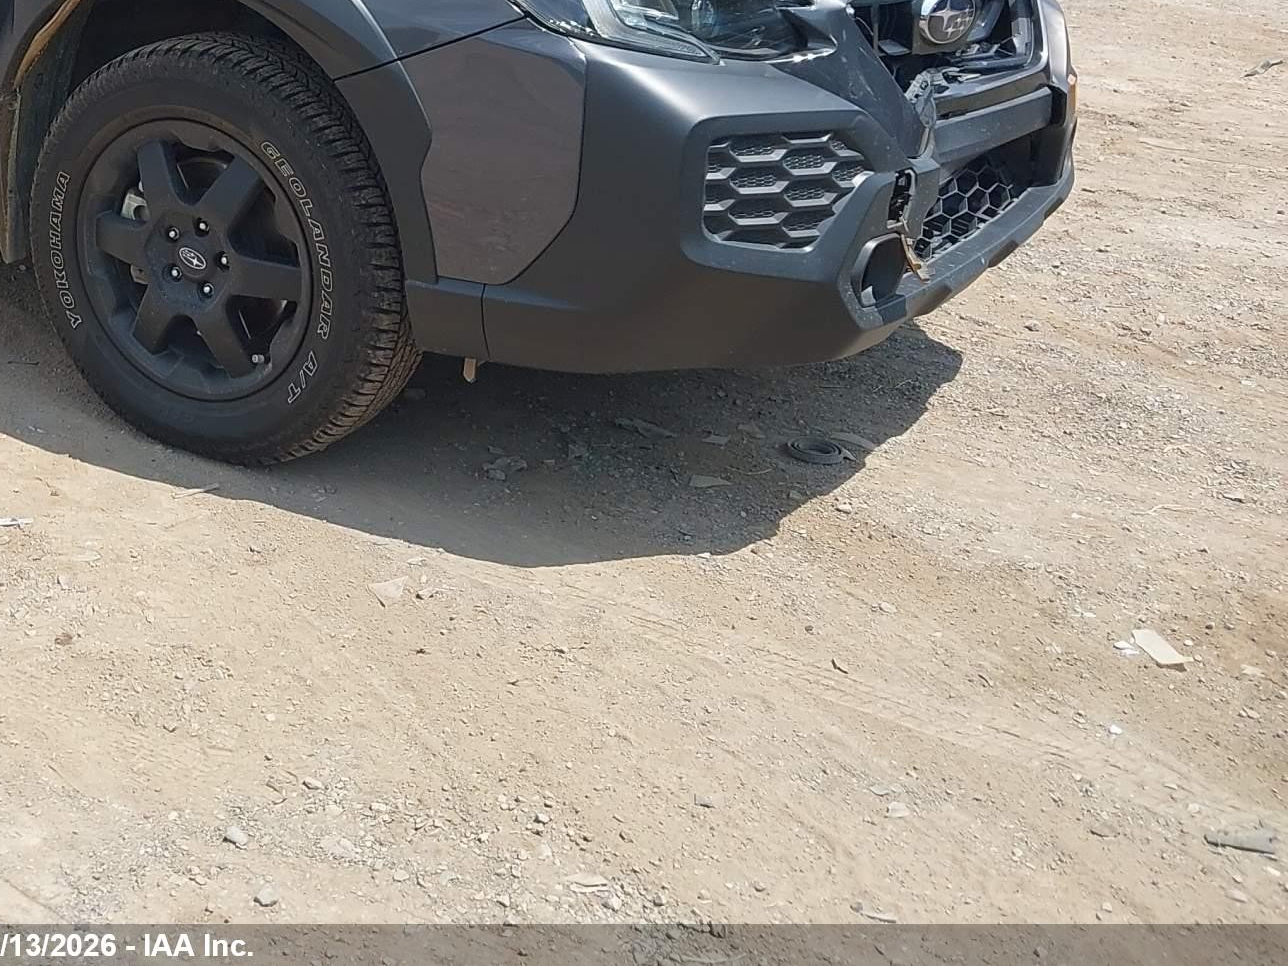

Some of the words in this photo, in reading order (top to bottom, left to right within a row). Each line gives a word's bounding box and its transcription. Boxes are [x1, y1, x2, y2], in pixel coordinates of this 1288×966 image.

[49, 169, 81, 329] YOKOHAMA
[260, 140, 337, 340] GEOLANDAR
[287, 350, 319, 404] A/T
